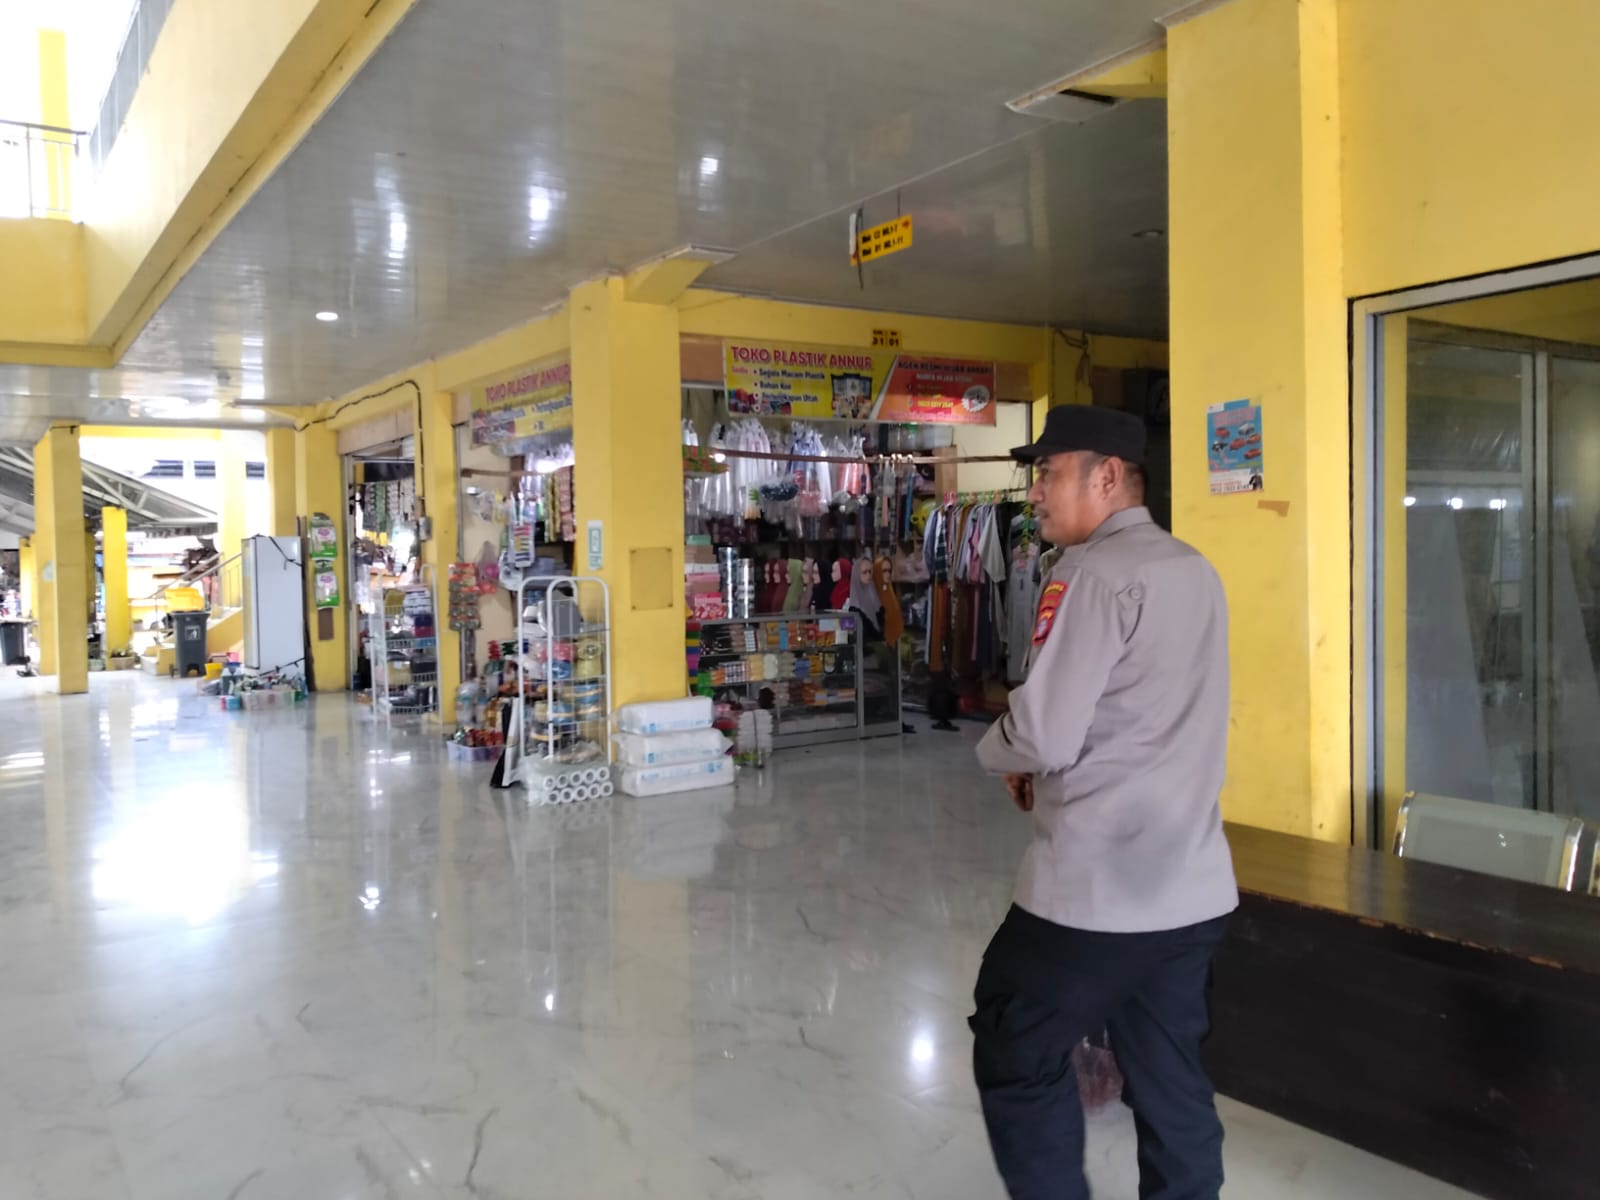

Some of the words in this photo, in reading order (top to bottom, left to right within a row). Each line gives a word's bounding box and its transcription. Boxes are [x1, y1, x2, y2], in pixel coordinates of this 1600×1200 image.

[731, 345, 770, 362] TOKO
[773, 349, 826, 368] PLASTIK
[829, 353, 872, 370] ANNUR
[485, 383, 506, 402] TOKO
[507, 373, 539, 396] PLASTIK
